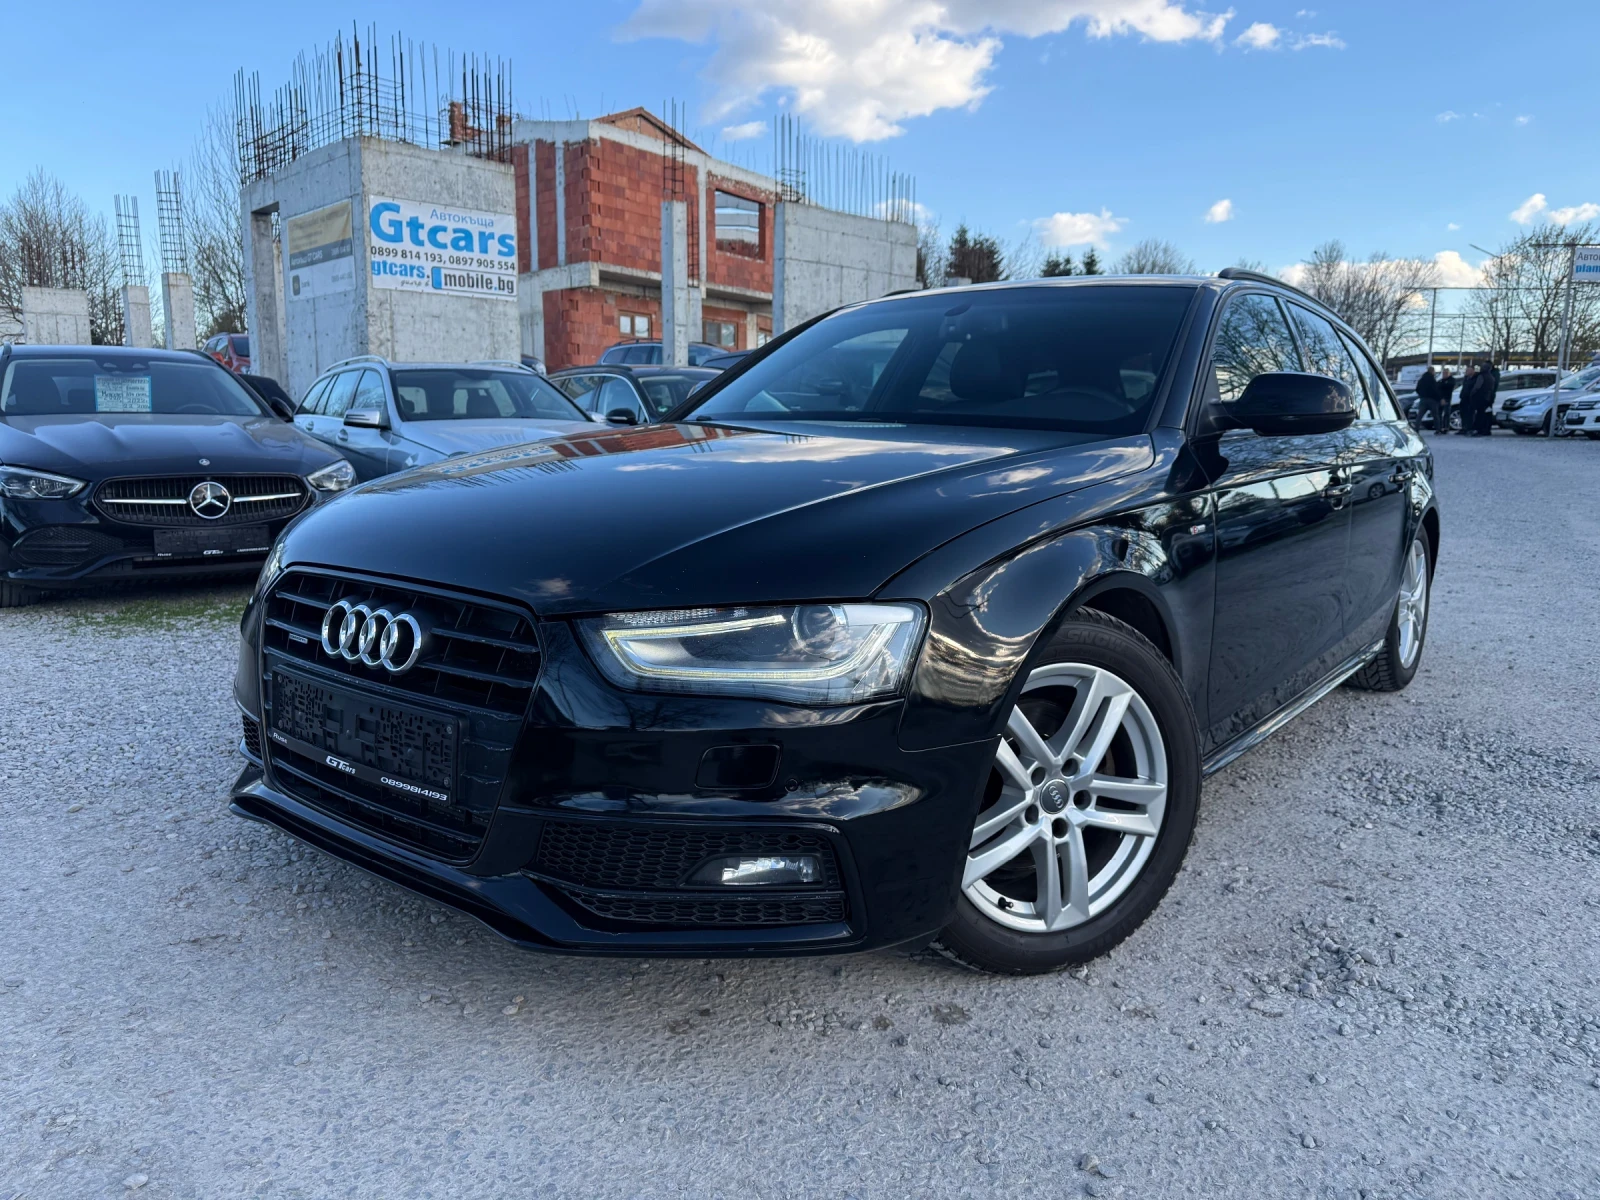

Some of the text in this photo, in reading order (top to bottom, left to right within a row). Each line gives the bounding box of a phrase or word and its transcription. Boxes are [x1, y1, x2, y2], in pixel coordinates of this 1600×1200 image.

[369, 202, 516, 257] Gtcars
[430, 208, 494, 228] Автокъща
[370, 246, 515, 271] 0899 814 193, 0897 905 554
[1576, 252, 1600, 261] Авто
[443, 272, 514, 294] mobile.bg
[380, 776, 448, 801] 0899814193
